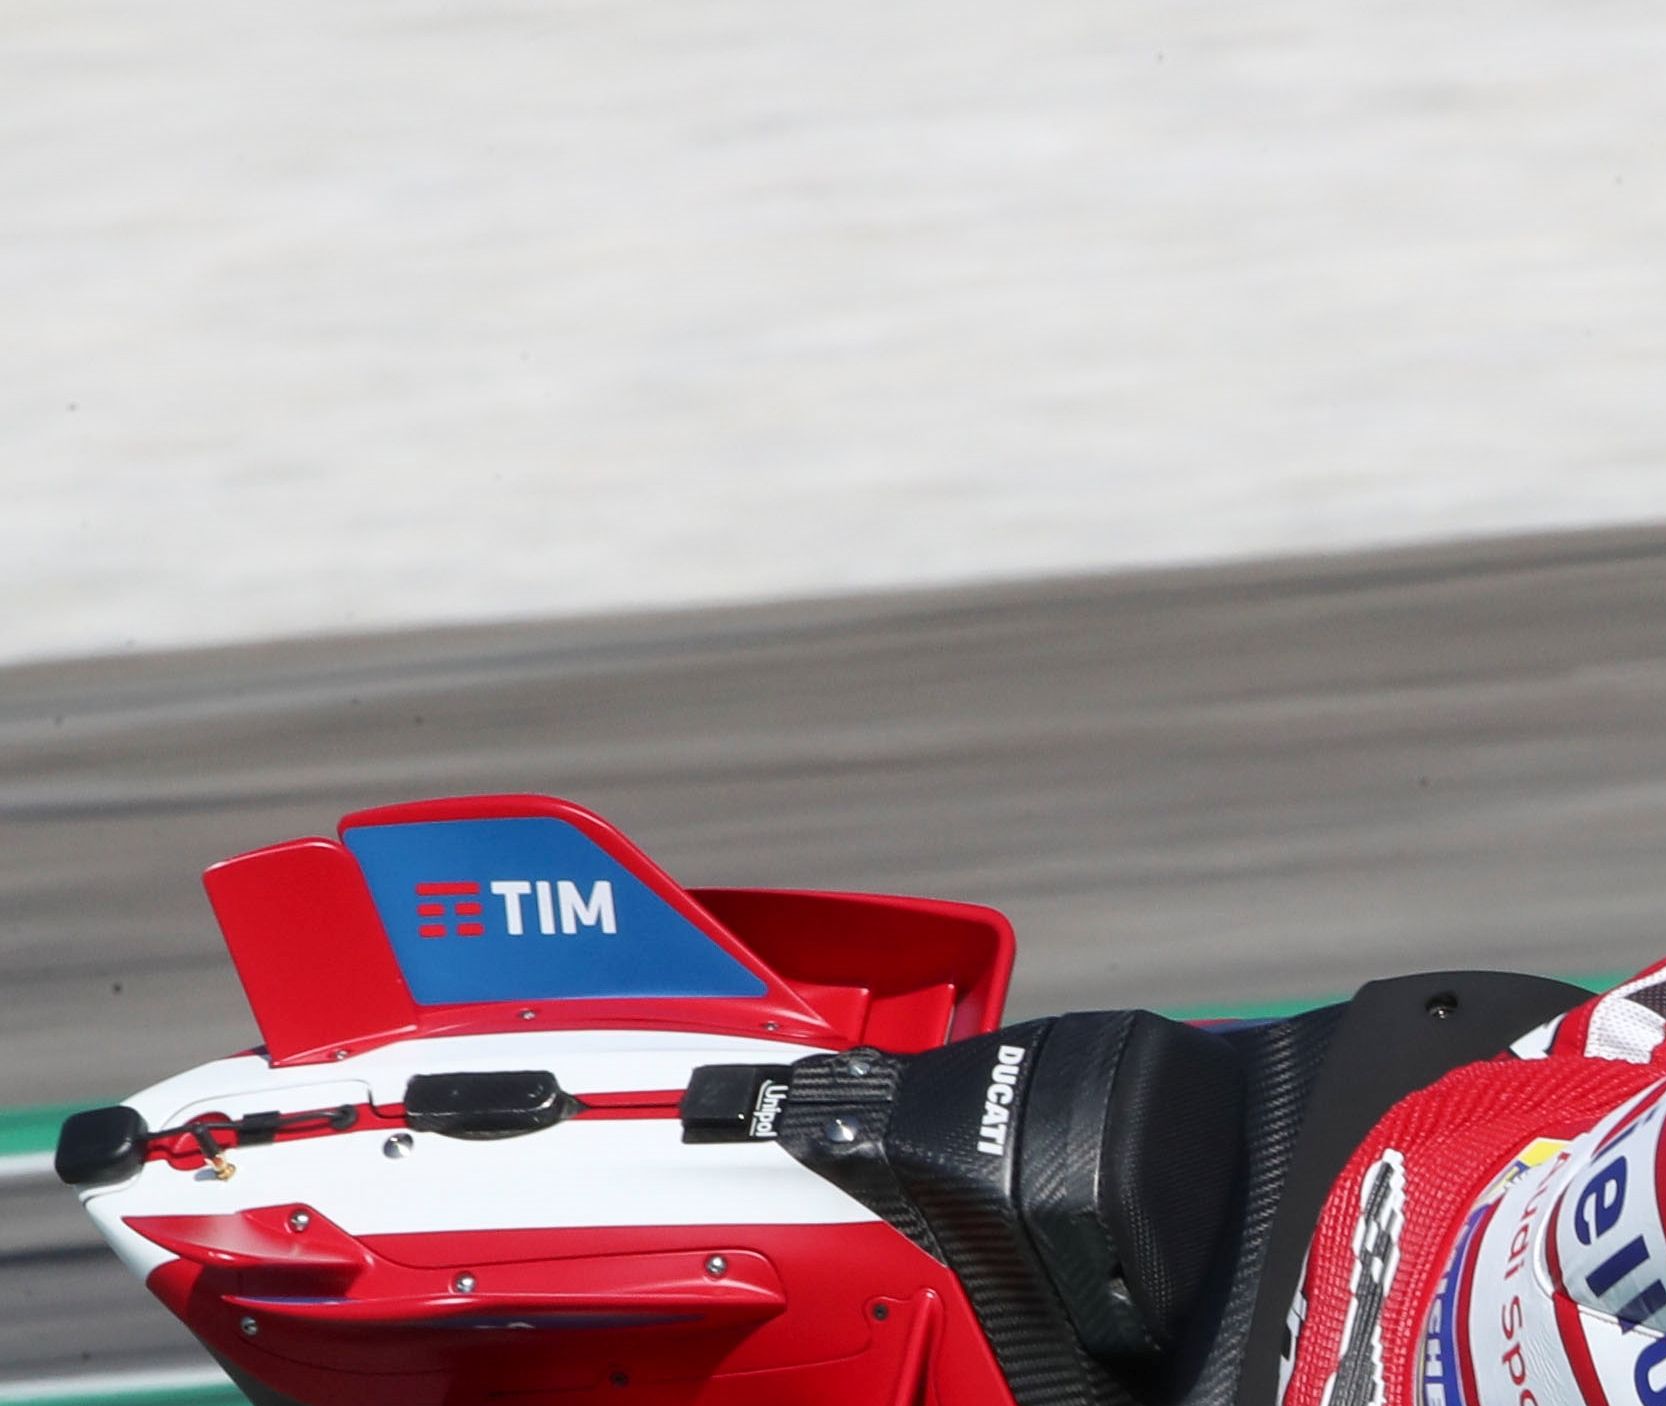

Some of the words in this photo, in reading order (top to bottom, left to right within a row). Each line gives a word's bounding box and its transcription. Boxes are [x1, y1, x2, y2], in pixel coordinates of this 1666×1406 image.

[491, 880, 617, 935] TIM
[753, 1083, 788, 1137] Unipol
[977, 1045, 1025, 1156] DUCATI
